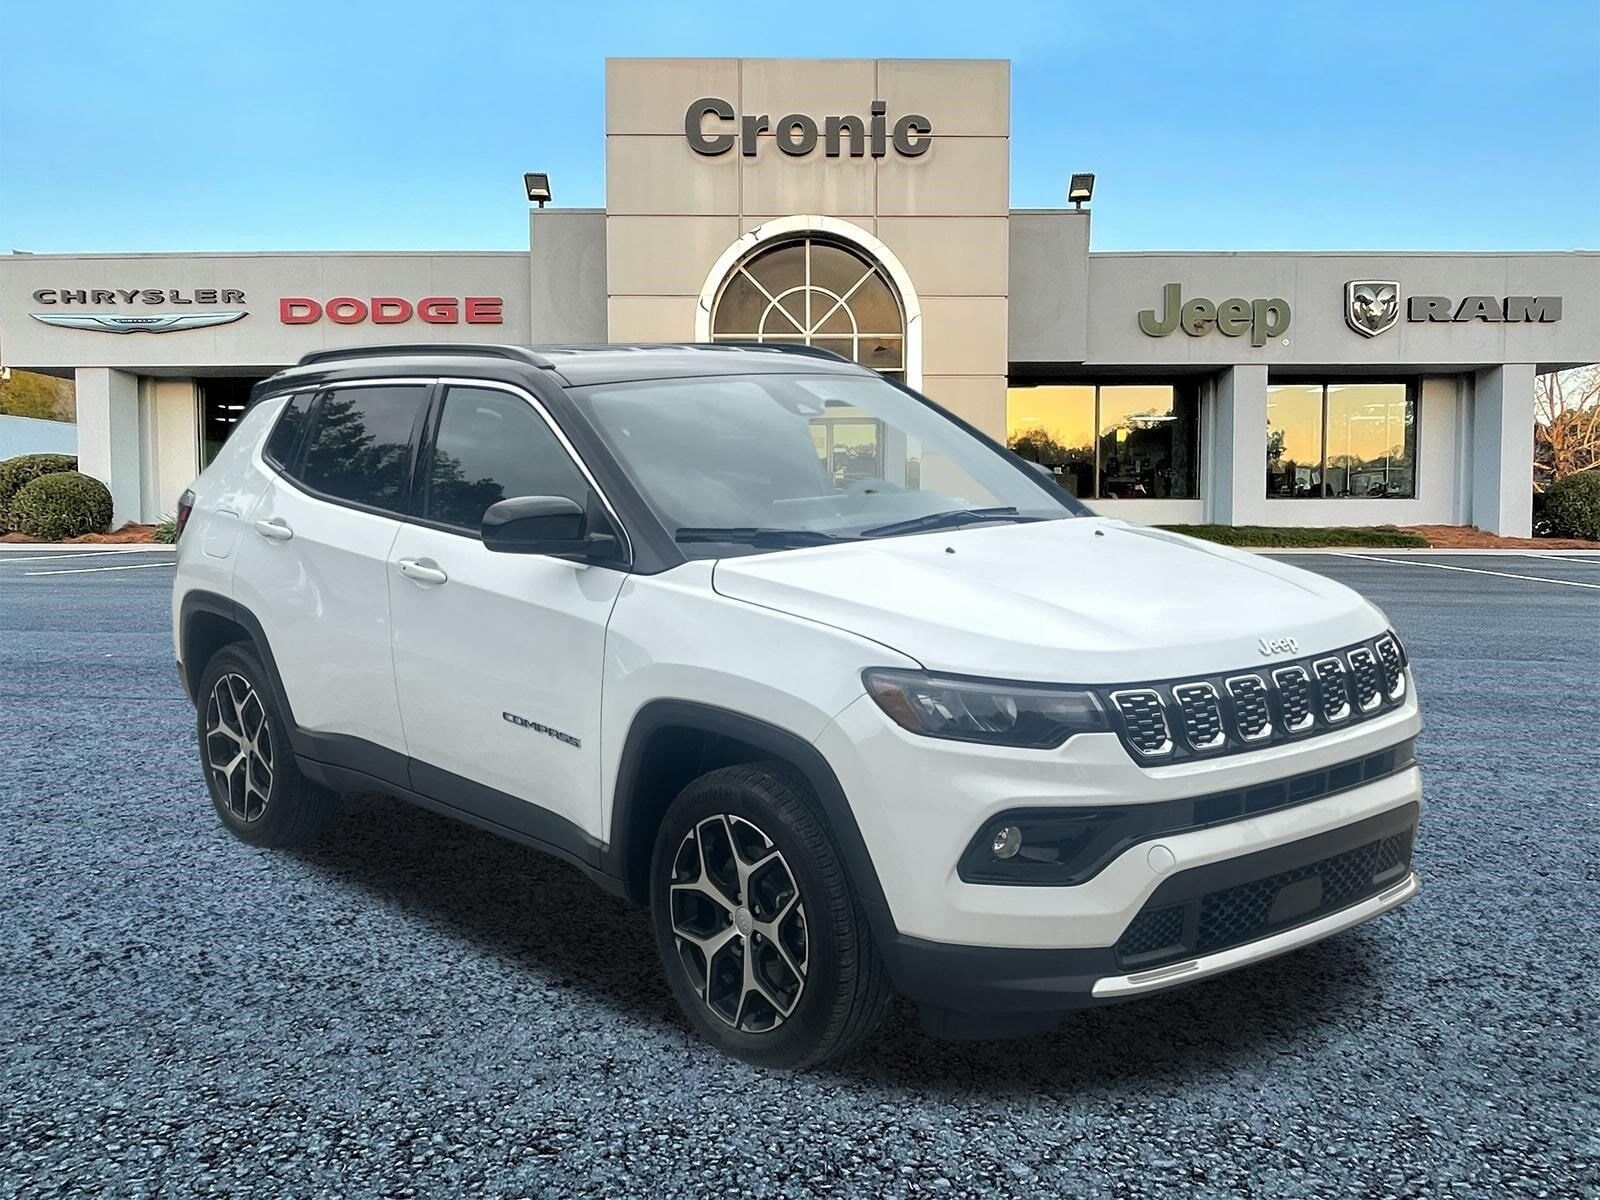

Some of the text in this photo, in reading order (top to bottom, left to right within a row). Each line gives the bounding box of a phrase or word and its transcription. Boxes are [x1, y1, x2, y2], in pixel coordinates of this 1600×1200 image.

[685, 98, 932, 157] Cronic
[32, 289, 246, 305] CHRYSLER
[280, 297, 503, 324] DODGE
[1408, 296, 1563, 322] RAM
[1138, 283, 1291, 347] Jeep
[1259, 636, 1299, 656] Jeep
[502, 711, 582, 749] COMPASS
